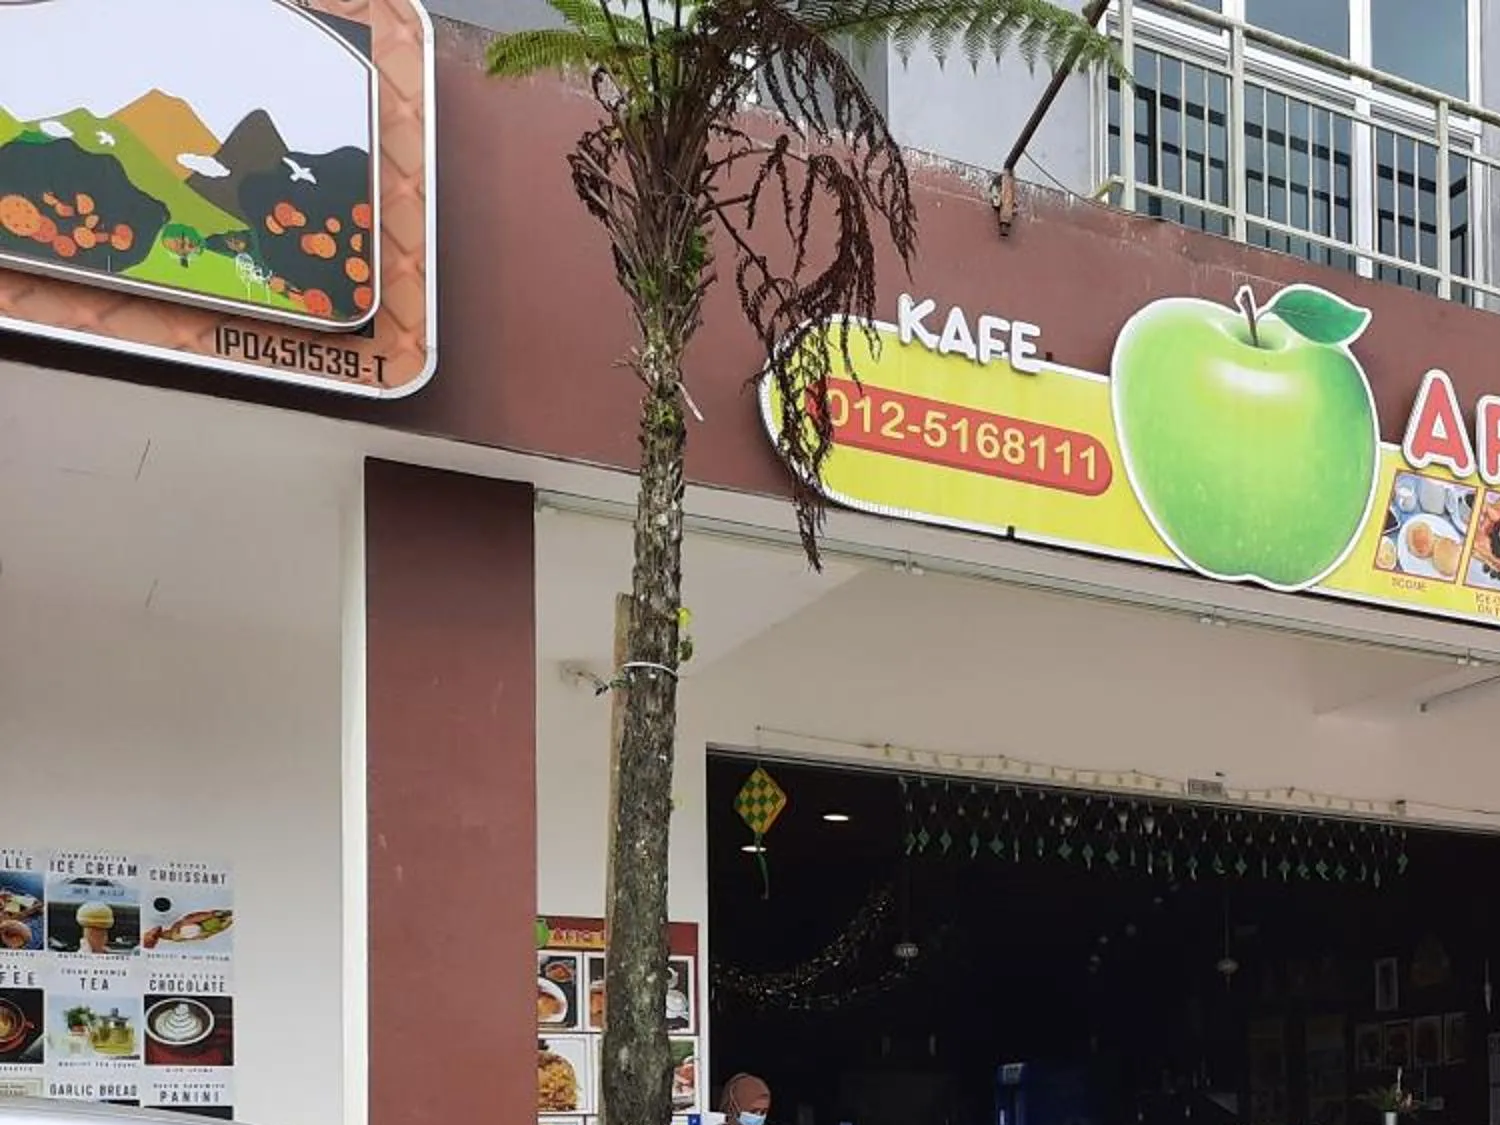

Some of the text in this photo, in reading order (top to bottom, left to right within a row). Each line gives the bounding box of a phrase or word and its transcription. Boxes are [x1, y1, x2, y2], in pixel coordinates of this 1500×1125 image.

[898, 293, 1042, 374] KAFE
[825, 388, 1097, 481] 012-5168111
[49, 860, 138, 877] ICE CREAM
[80, 977, 110, 991] TEA
[149, 979, 226, 993] CHOCOLATE
[50, 1083, 94, 1097] GARLIC
[99, 1084, 138, 1098] BREAD
[159, 1090, 220, 1104] PANINI
